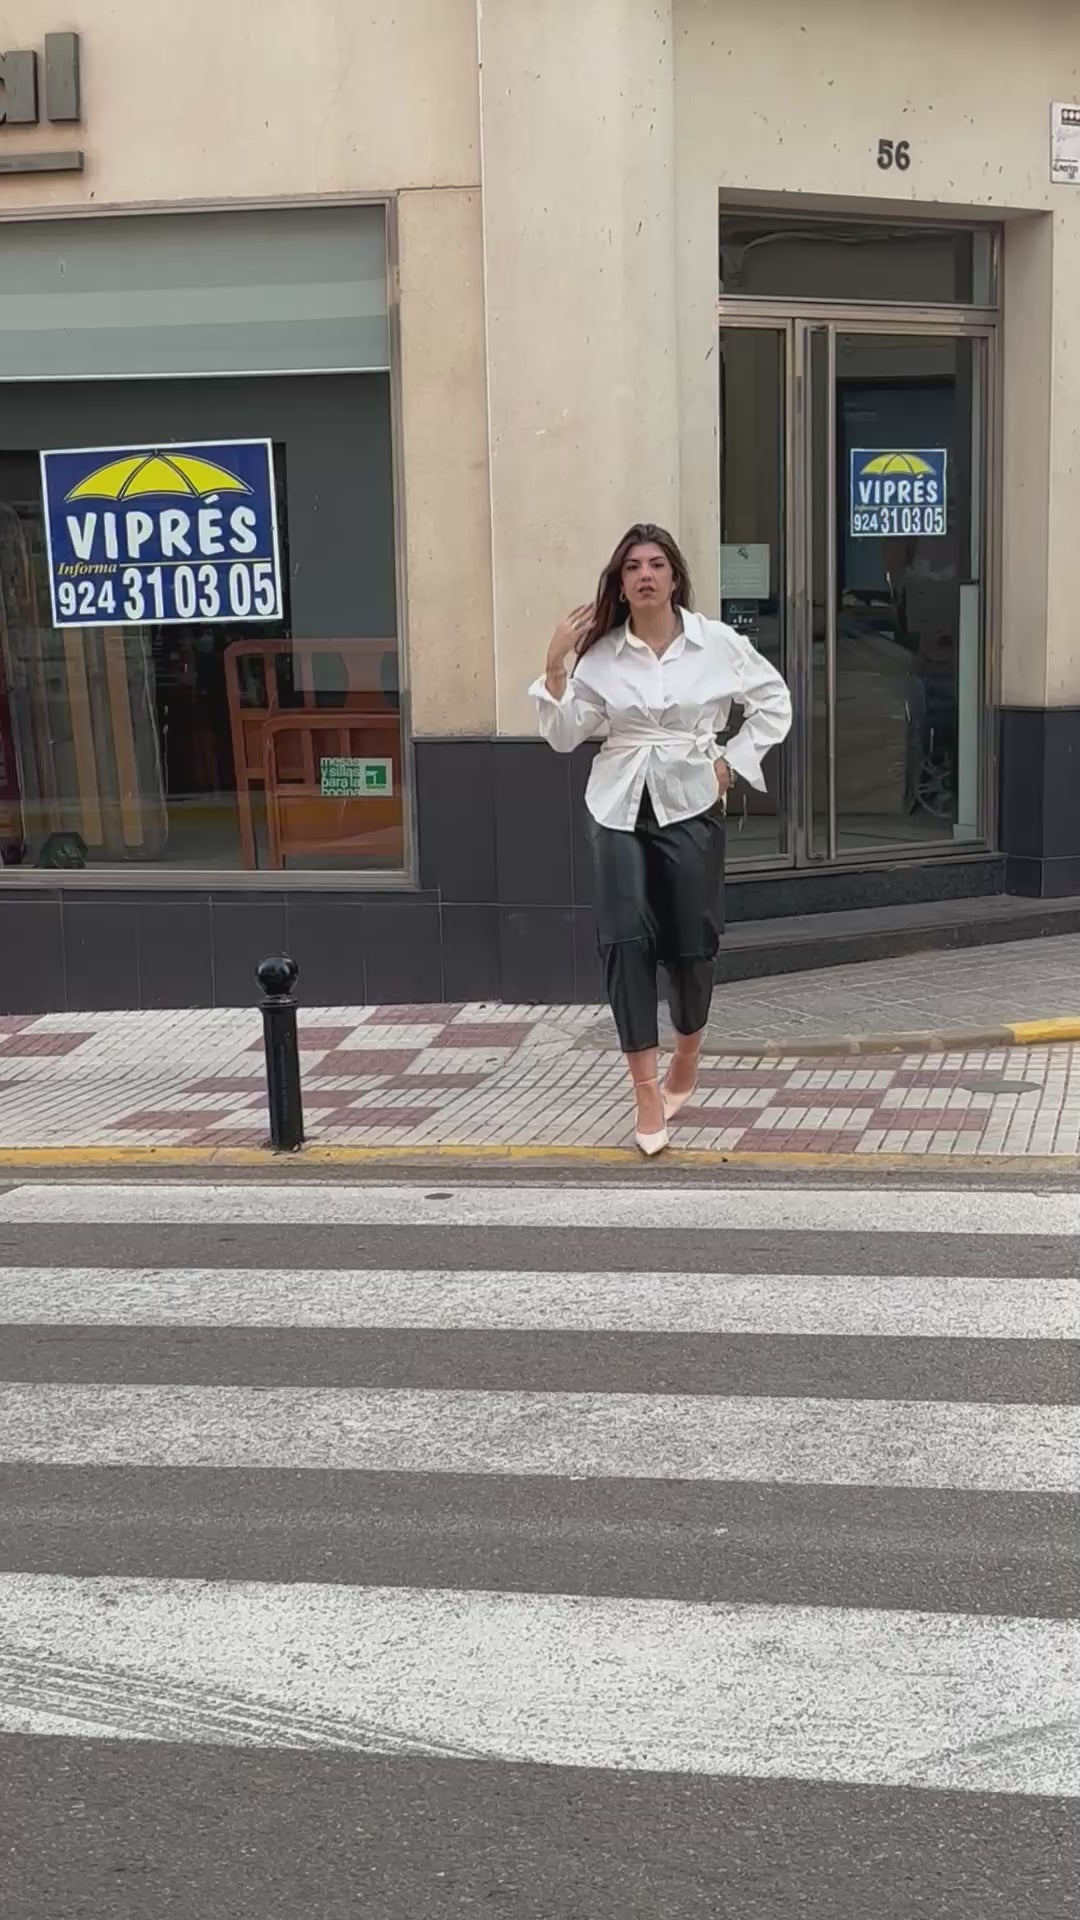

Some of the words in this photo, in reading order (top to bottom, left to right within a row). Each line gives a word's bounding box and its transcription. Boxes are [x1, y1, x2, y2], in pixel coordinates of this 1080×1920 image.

[877, 138, 911, 171] 56
[859, 473, 938, 504] VIPRÉS
[66, 494, 257, 560] VIPRÉS
[854, 513, 878, 531] 924
[881, 508, 898, 533] 31
[902, 508, 921, 533] 03
[924, 507, 943, 533] 05
[57, 562, 117, 578] Informa
[58, 580, 116, 616] 924
[122, 566, 165, 620] 31
[174, 564, 221, 618] 03
[228, 562, 276, 616] 05
